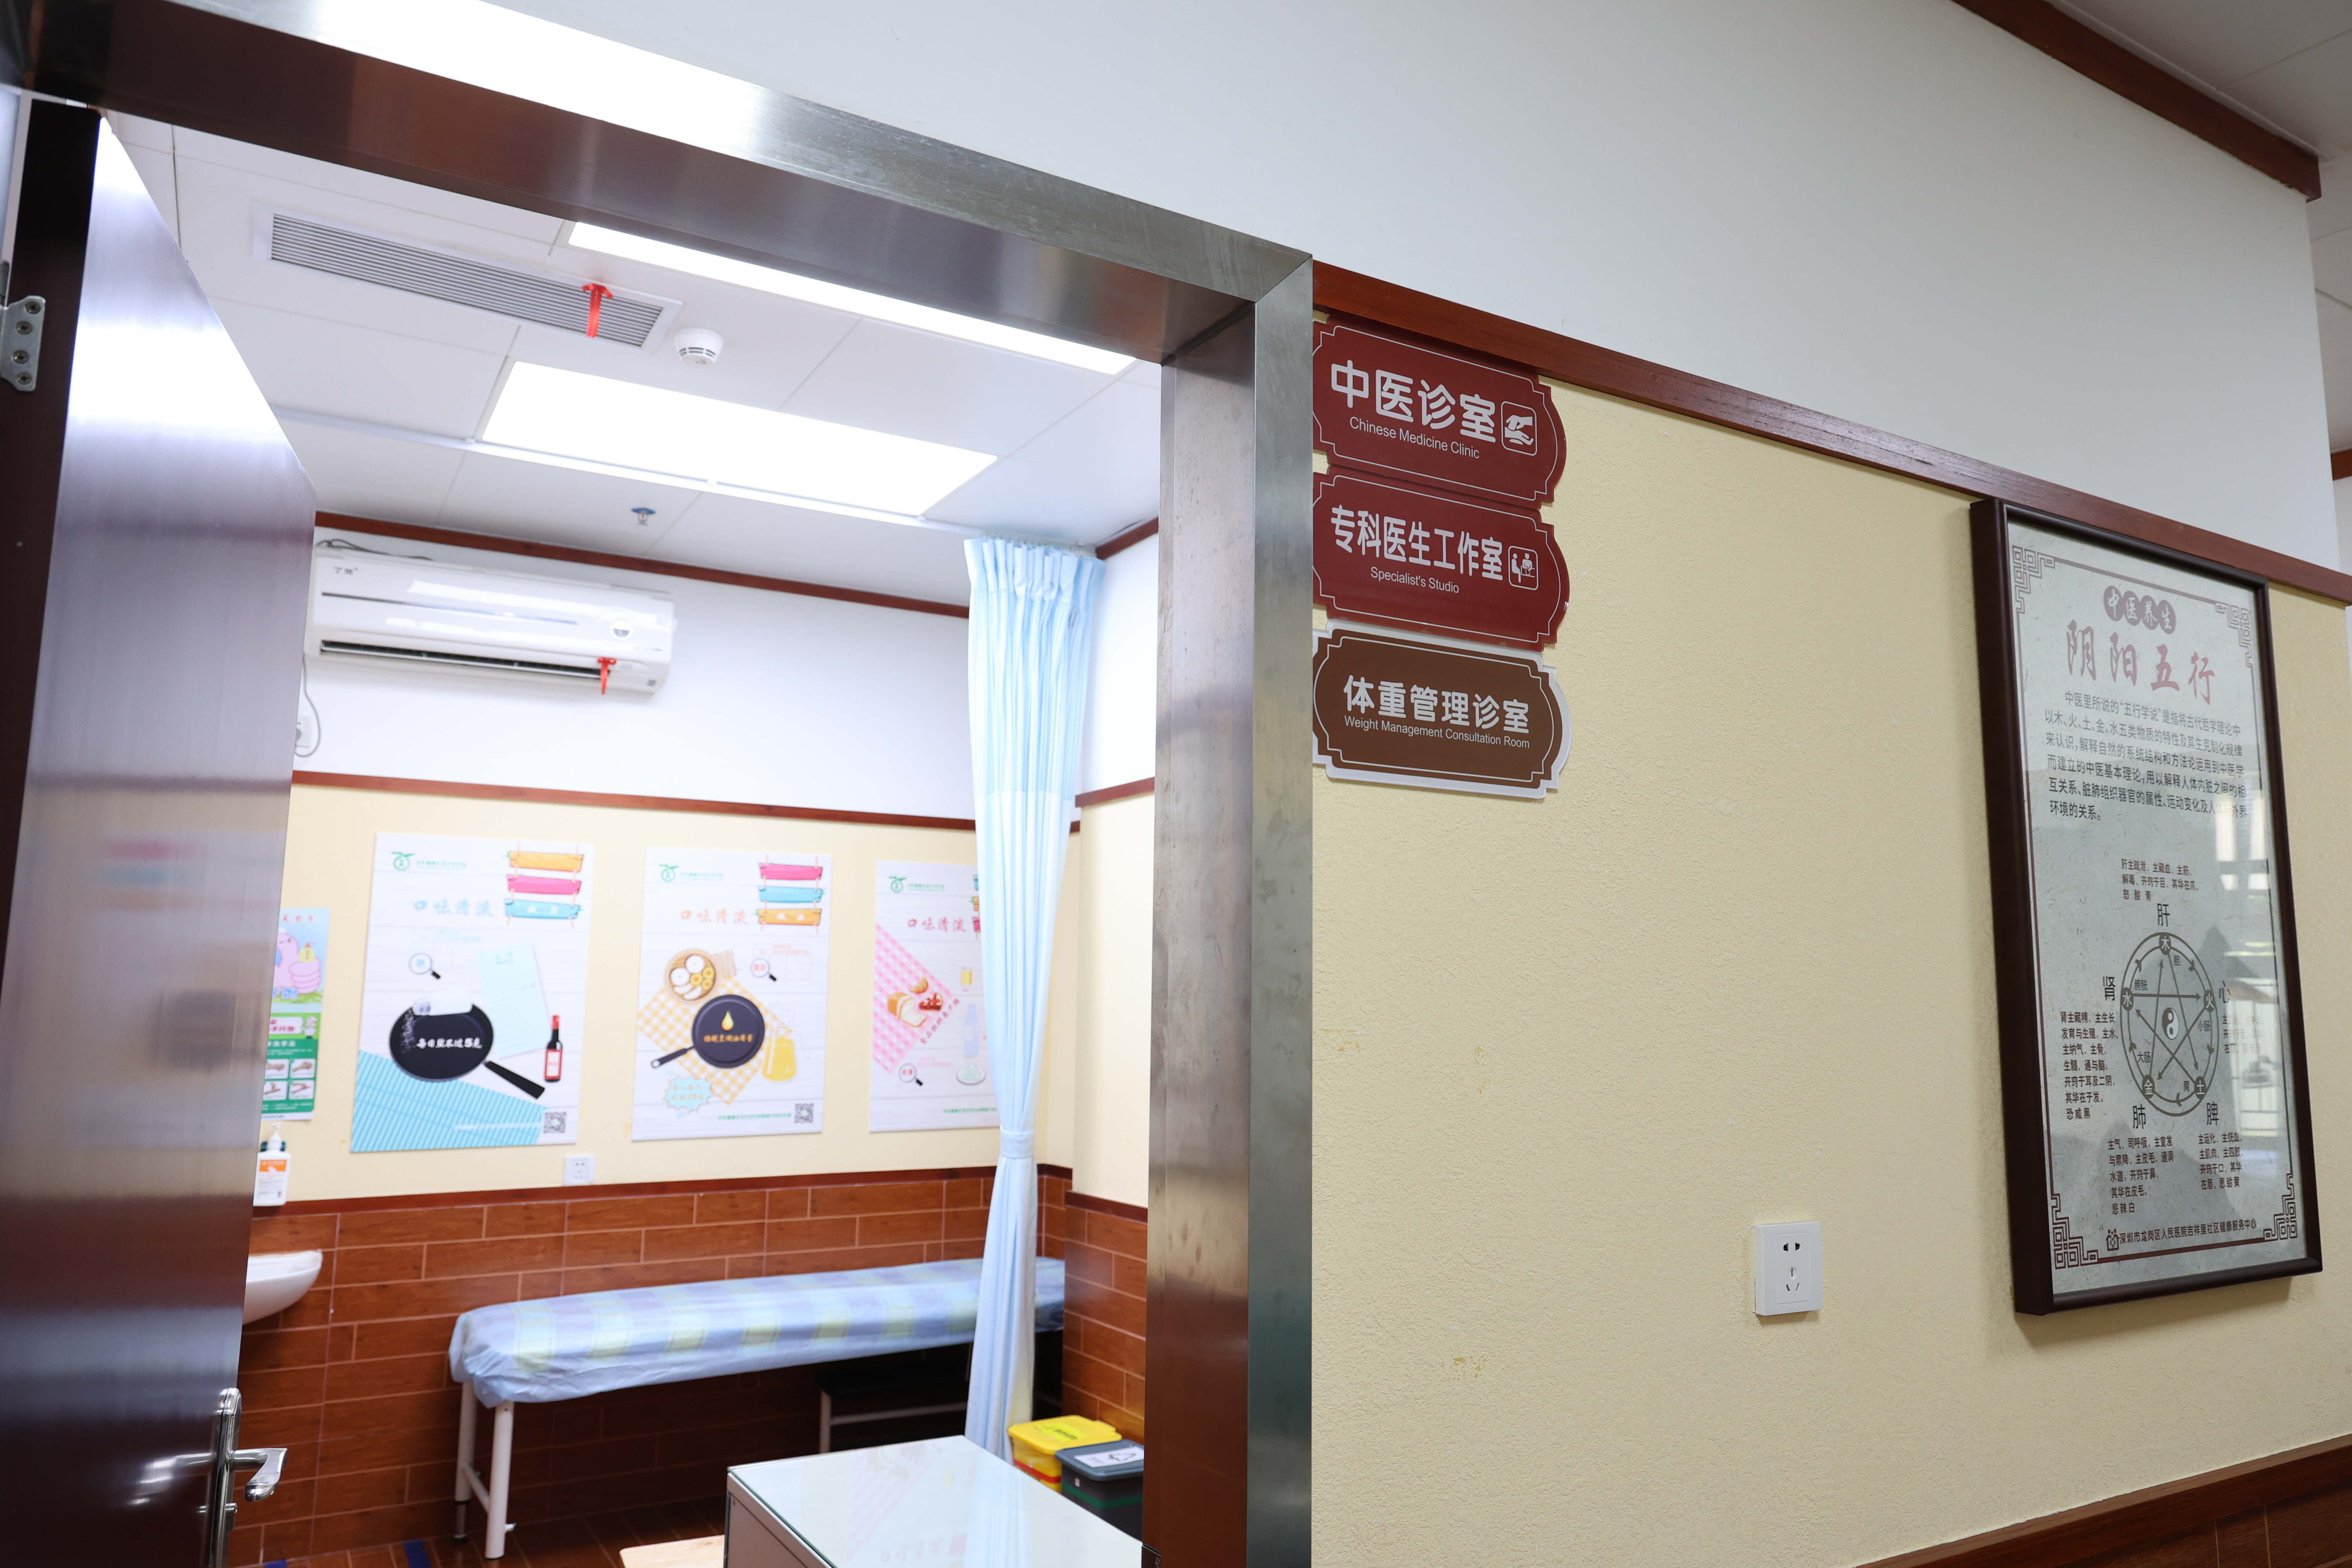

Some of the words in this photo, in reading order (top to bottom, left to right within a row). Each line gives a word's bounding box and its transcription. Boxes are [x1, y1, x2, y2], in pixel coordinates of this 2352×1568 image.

[1331, 359, 1496, 443] 中医诊室
[1350, 416, 1396, 439] Chinese
[1399, 428, 1448, 451] Medicine
[1450, 441, 1480, 459] Clinic
[1331, 504, 1503, 581] 专科医生工作室
[1370, 567, 1426, 587] Specialist's
[1428, 577, 1459, 593] Studio
[2105, 587, 2175, 633] 中医养生
[2066, 619, 2216, 705] 阴阳五行
[1343, 674, 1529, 734] 体重管理诊室
[1344, 715, 1379, 732] Weight
[1381, 720, 1443, 739] Management
[1445, 729, 1501, 745] Consultation
[1504, 736, 1530, 748] Room
[2049, 800, 2101, 820] 环境的关系。
[2157, 903, 2171, 927] 肝
[2161, 938, 2170, 951] 木
[2102, 975, 2116, 1002] 肾
[2123, 991, 2132, 1007] 水
[2206, 993, 2215, 1008] 火
[2219, 980, 2231, 1004] 心
[2198, 1020, 2211, 1032] 小肠
[2137, 1051, 2151, 1063] 大肠
[2065, 1091, 2103, 1103] 其华在于发。
[2144, 1079, 2154, 1095] 金
[2196, 1080, 2205, 1094] 土
[2132, 1103, 2146, 1129] 肺
[2206, 1101, 2220, 1126] 脾
[2111, 1185, 2147, 1198] 其华在皮毛。
